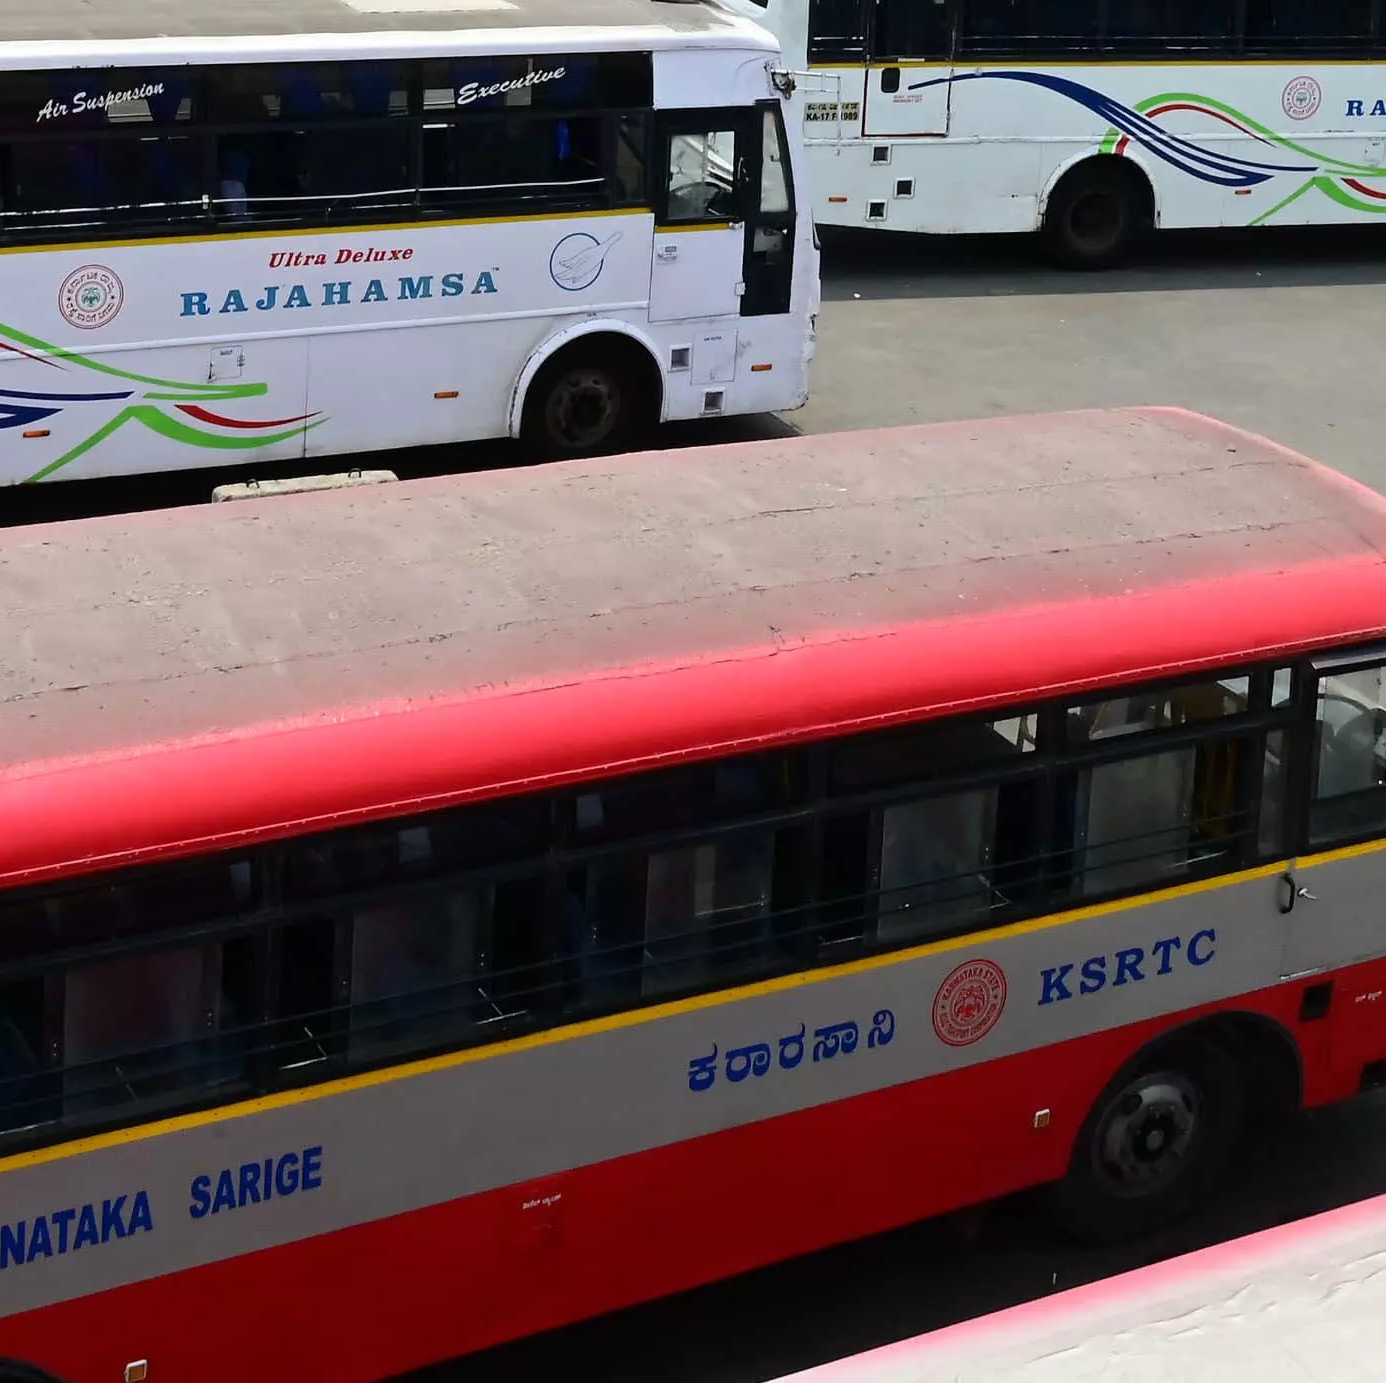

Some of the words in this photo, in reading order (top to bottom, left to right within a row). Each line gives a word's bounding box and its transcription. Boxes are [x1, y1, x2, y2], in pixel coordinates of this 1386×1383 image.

[37, 97, 69, 123] Air
[70, 80, 166, 116] Suspension
[455, 65, 567, 106] Executive
[269, 252, 327, 268] Ultra
[334, 247, 414, 265] Deluxe
[180, 271, 498, 316] RAJAHAMSA
[1037, 928, 1218, 1006] KSRTC
[189, 1146, 324, 1219] SARIGE
